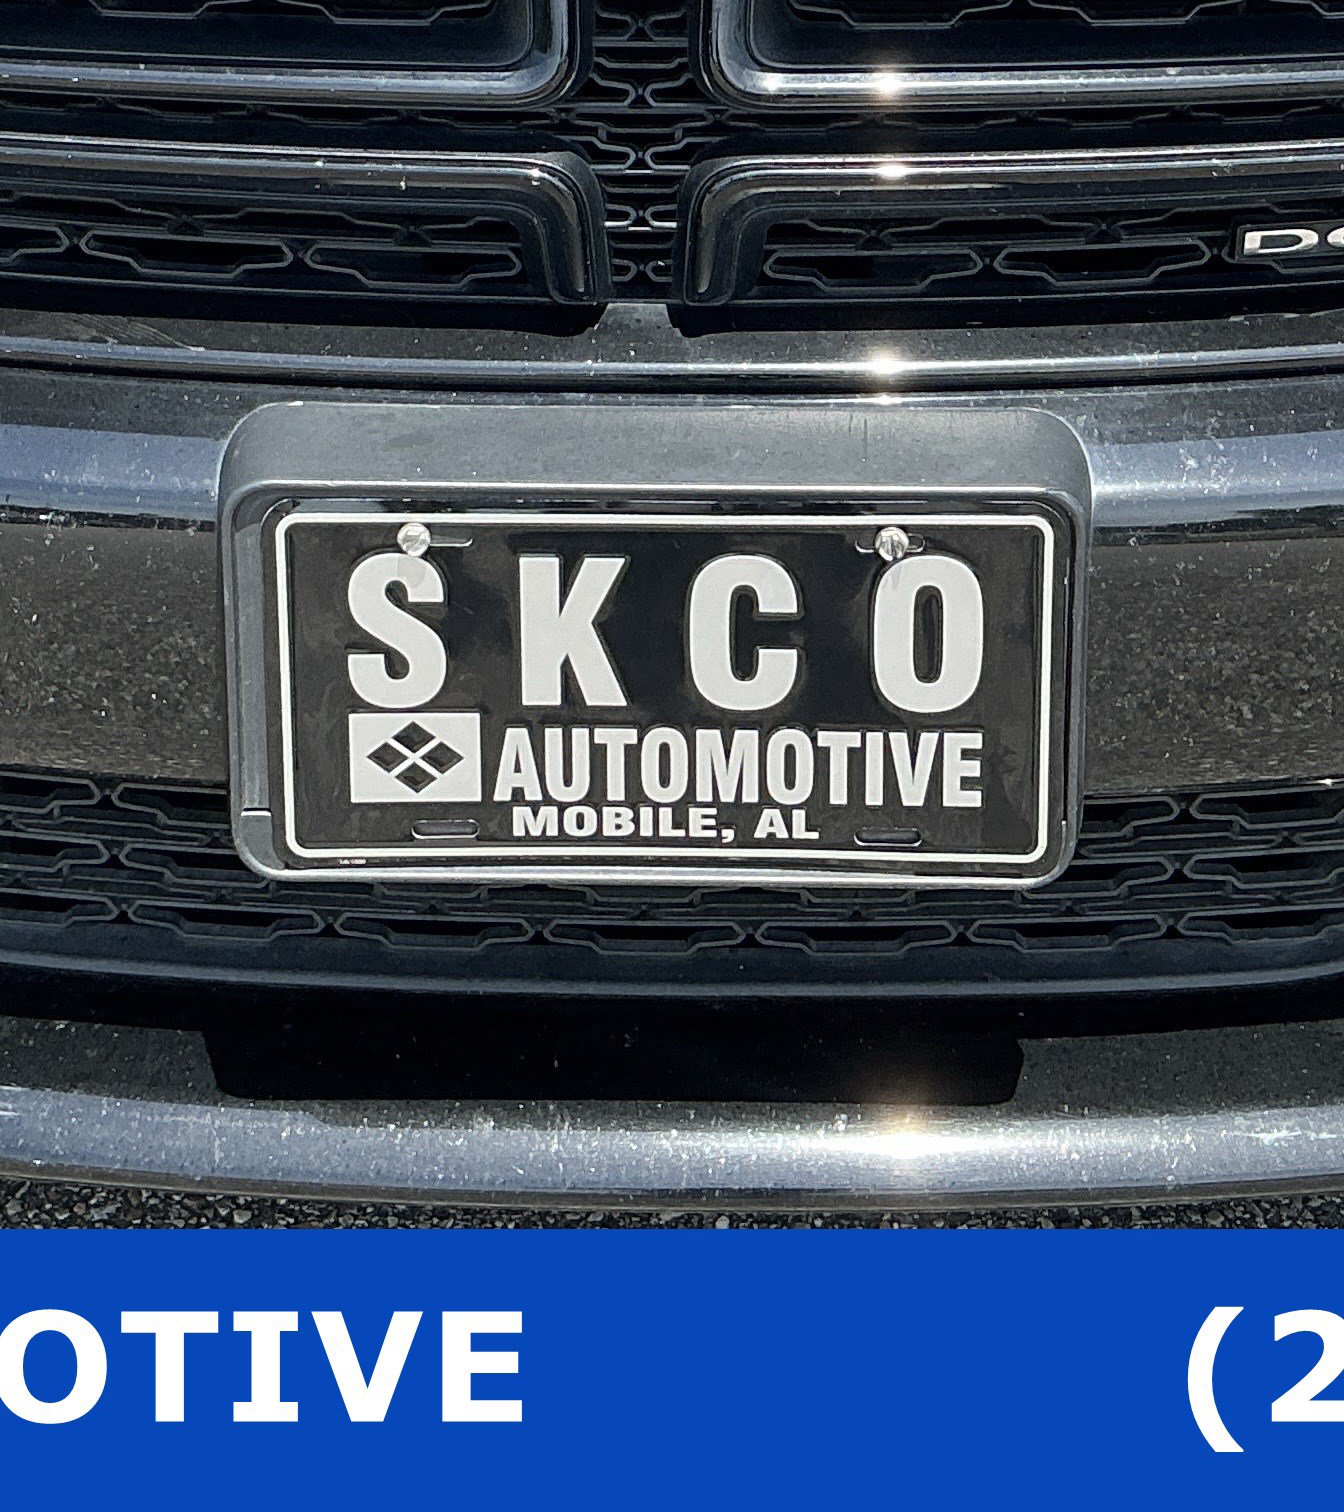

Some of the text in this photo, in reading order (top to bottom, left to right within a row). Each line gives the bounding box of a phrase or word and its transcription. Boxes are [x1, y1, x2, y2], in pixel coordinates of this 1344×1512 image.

[346, 552, 984, 714] SKCO
[493, 726, 983, 808] AUTOMOTIVE
[512, 806, 820, 843] MOBILE, AL
